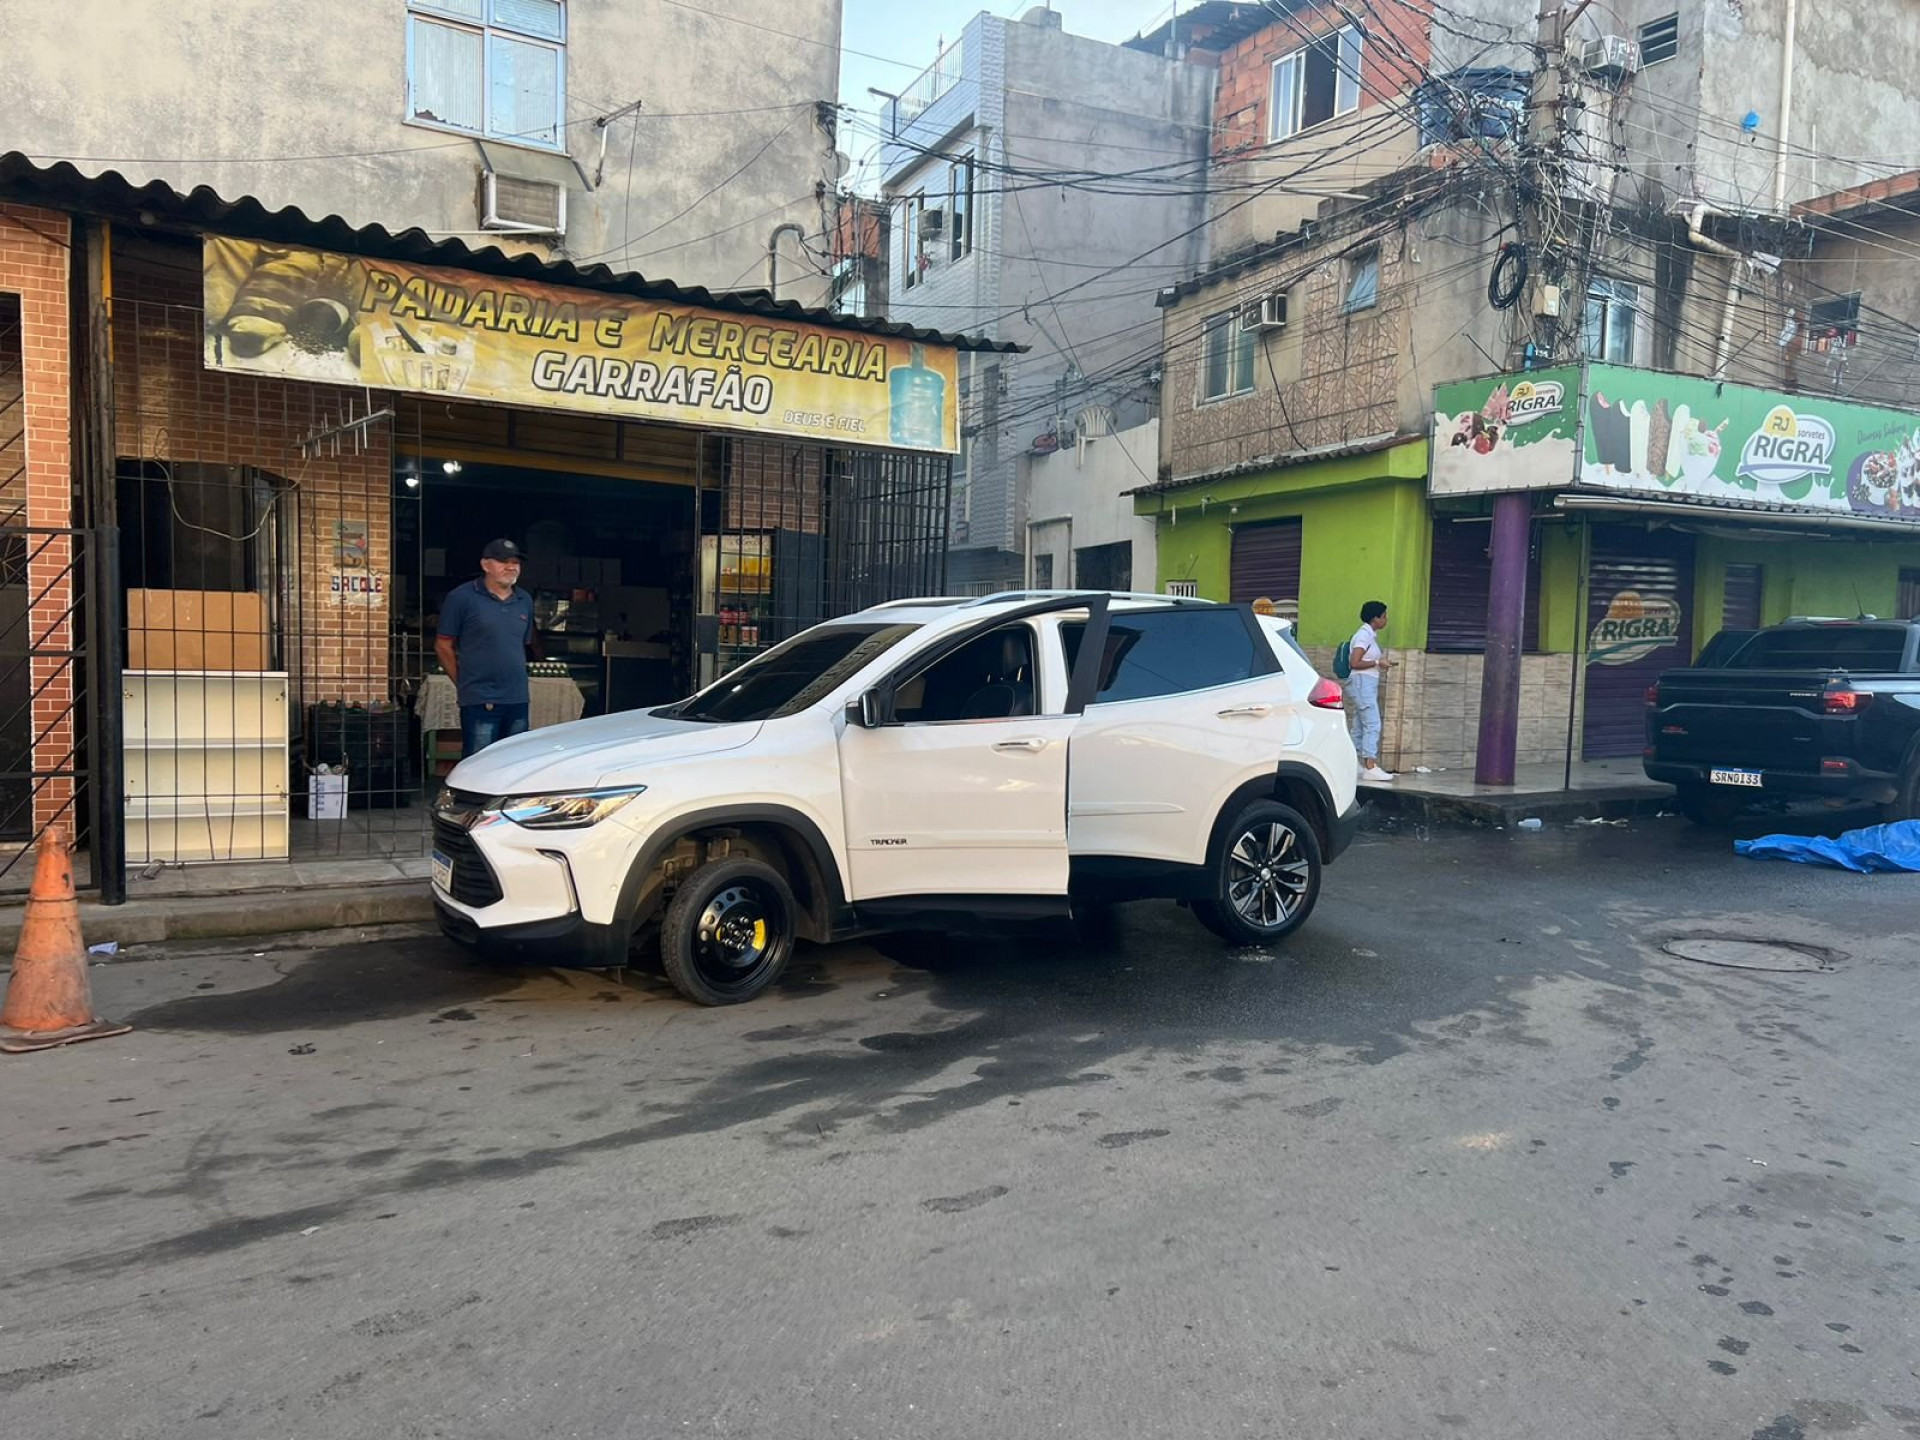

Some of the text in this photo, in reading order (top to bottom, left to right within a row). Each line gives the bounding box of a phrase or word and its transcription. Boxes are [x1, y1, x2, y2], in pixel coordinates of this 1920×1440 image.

[359, 269, 887, 382] PADARIA E MERCEARIA
[532, 350, 773, 415] GARRAFÃO
[1506, 395, 1556, 412] RIGRA
[784, 410, 866, 432] DEUS É FIEL
[1753, 435, 1826, 465] RIGRA
[1601, 617, 1670, 642] RIGRA
